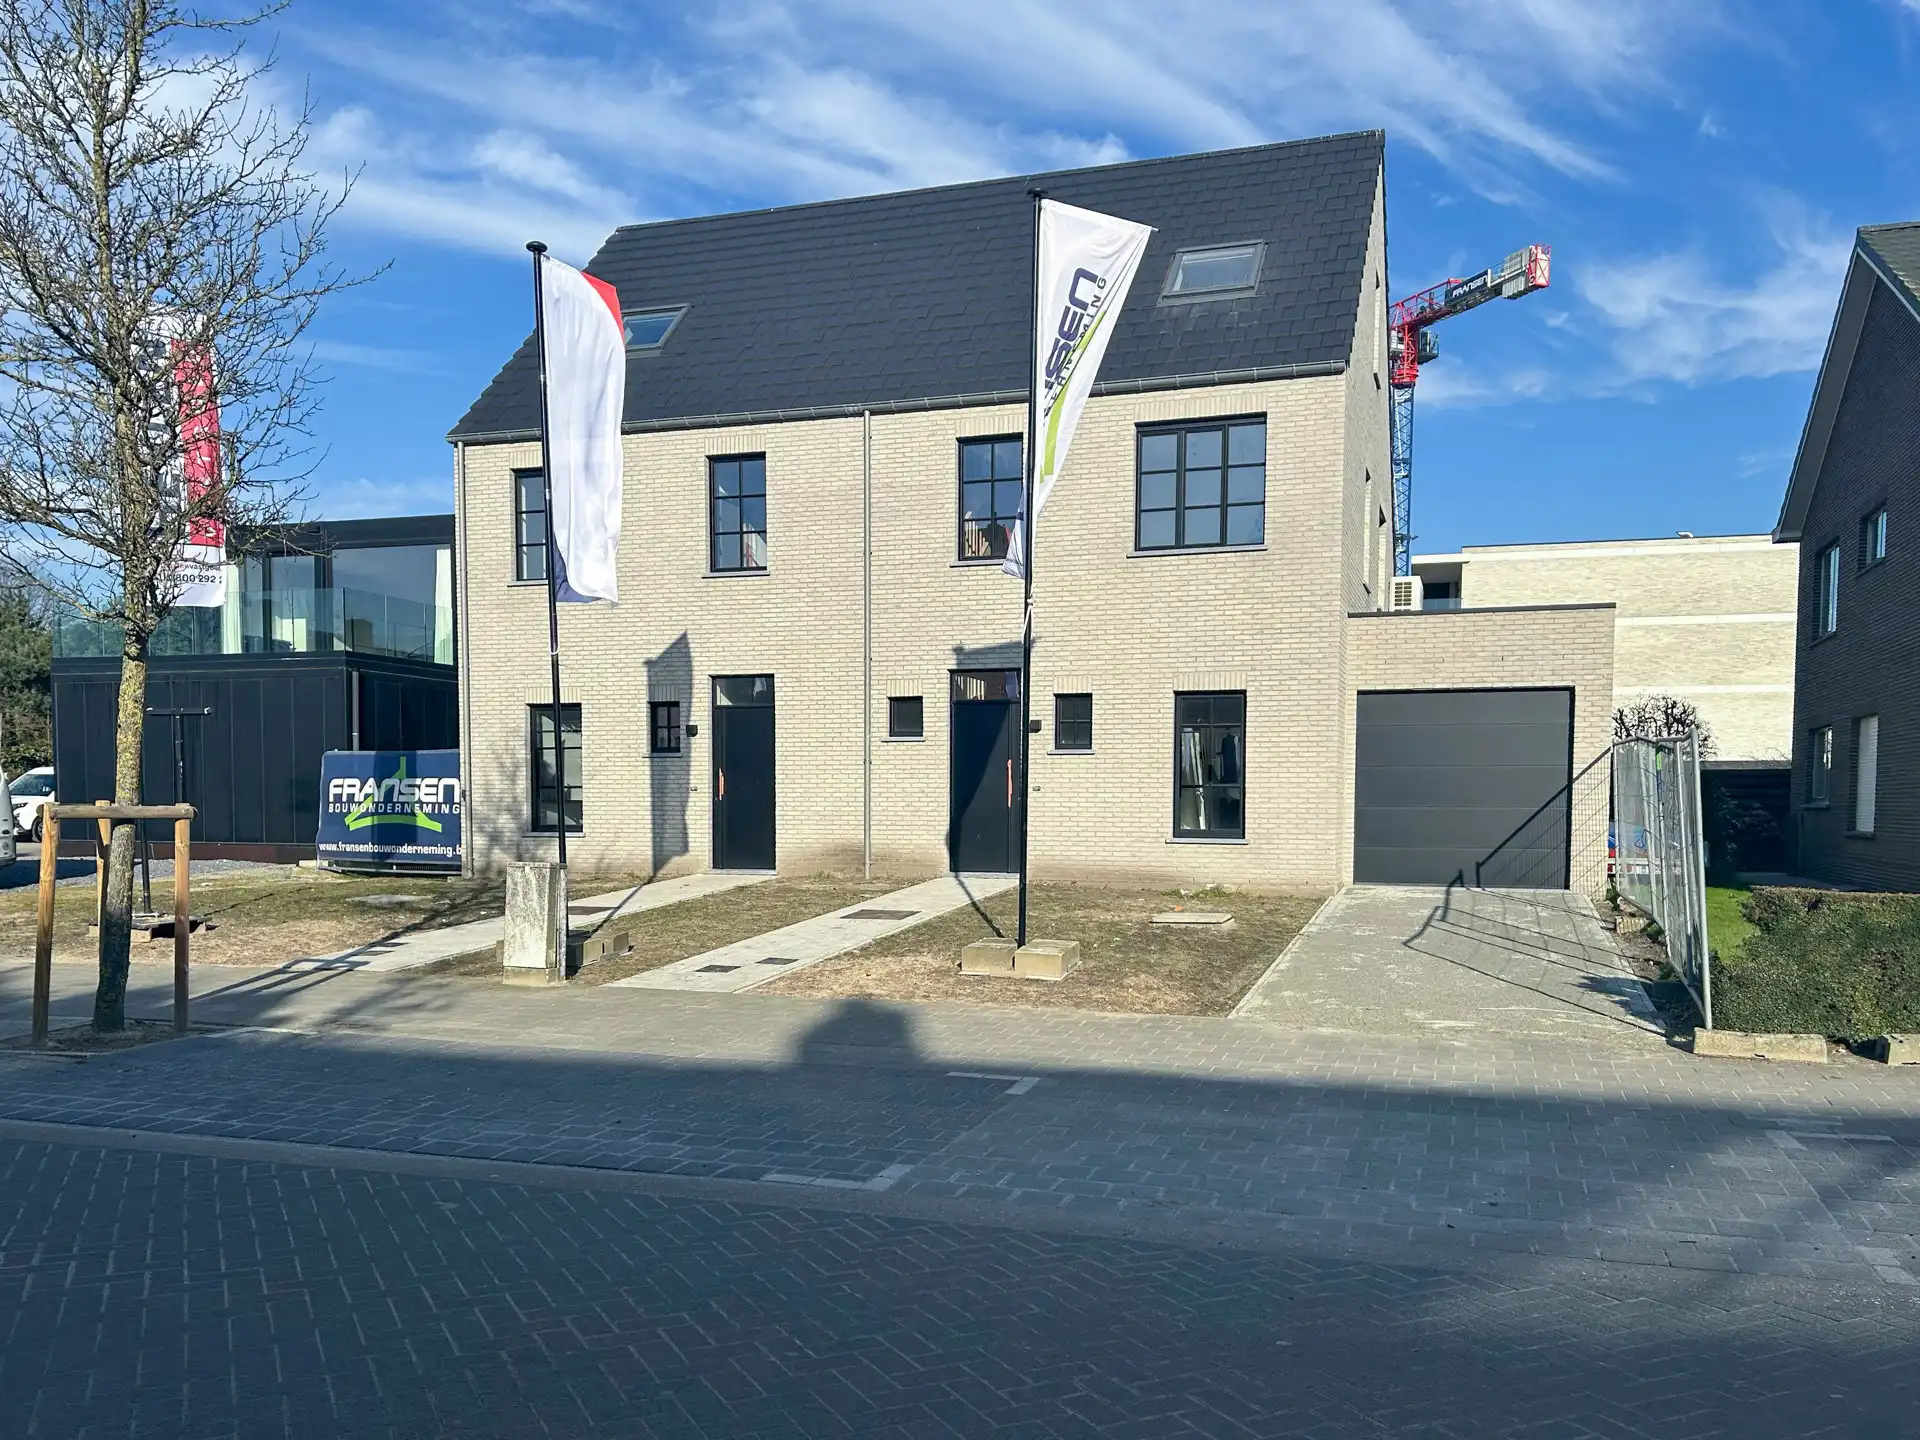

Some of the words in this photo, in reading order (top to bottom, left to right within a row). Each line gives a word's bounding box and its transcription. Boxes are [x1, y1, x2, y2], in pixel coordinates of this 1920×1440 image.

[1452, 274, 1489, 299] FRANSEN
[1045, 267, 1099, 391] SEN
[328, 777, 461, 803] FRANSEN
[328, 803, 461, 814] BOUWONDERNEMING
